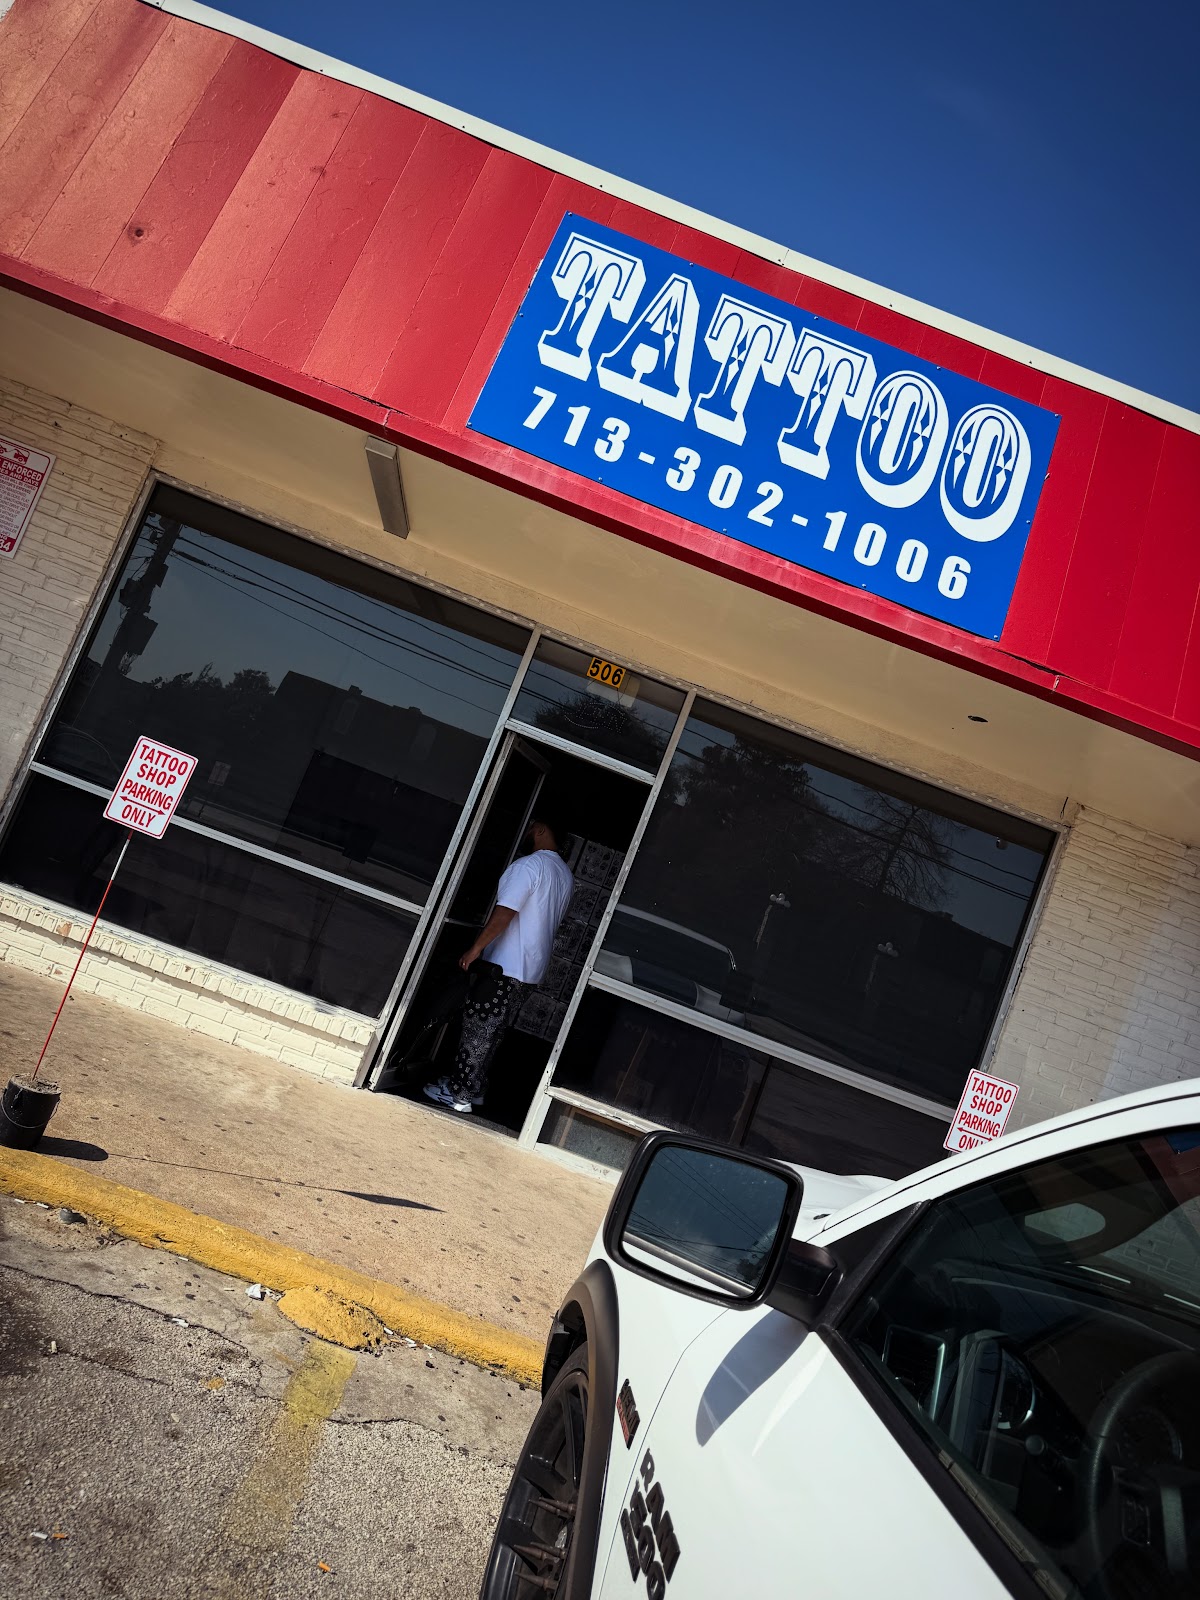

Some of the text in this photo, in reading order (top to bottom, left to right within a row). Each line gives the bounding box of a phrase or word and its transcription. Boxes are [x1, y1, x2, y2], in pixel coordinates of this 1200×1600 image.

[537, 232, 1032, 542] TATTOO
[1, 460, 42, 481] ENFORCED
[522, 386, 971, 600] 713-302-1006
[589, 659, 624, 686] 506
[139, 743, 189, 776] TATTOO
[136, 763, 177, 789] SHOP
[121, 778, 174, 811] PARKING
[121, 804, 156, 828] ONLY
[971, 1077, 1012, 1104] TATTOO
[970, 1095, 1003, 1117] SHOP
[958, 1111, 1001, 1138] PARKING
[958, 1134, 984, 1150] ON
[640, 1447, 681, 1584] RAM
